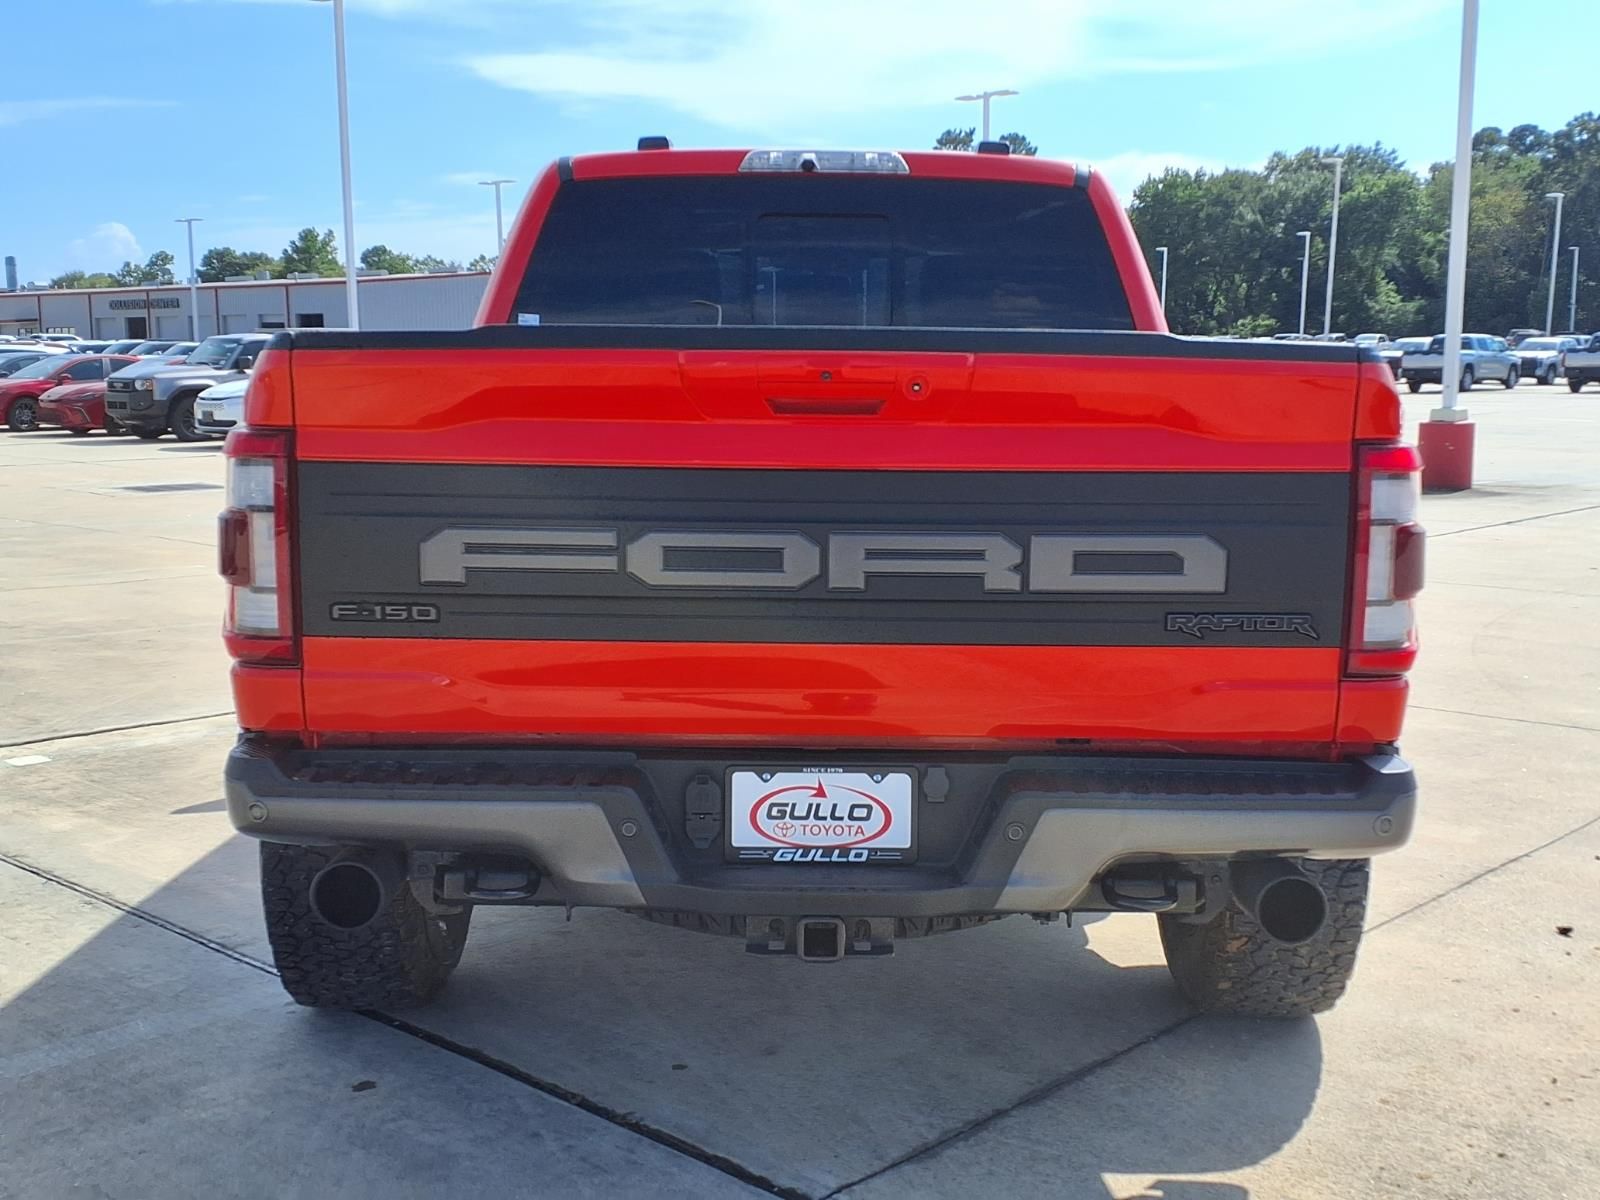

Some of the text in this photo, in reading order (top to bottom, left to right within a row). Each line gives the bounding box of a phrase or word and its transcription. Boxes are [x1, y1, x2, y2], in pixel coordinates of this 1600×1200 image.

[109, 297, 180, 310] COLLISION CENTER
[419, 526, 1228, 594] FORD
[331, 603, 438, 621] F-150
[1167, 614, 1319, 638] RAPTOR
[766, 802, 873, 822] GULLO
[800, 824, 865, 837] TOYOTA
[772, 848, 869, 862] GULLO
